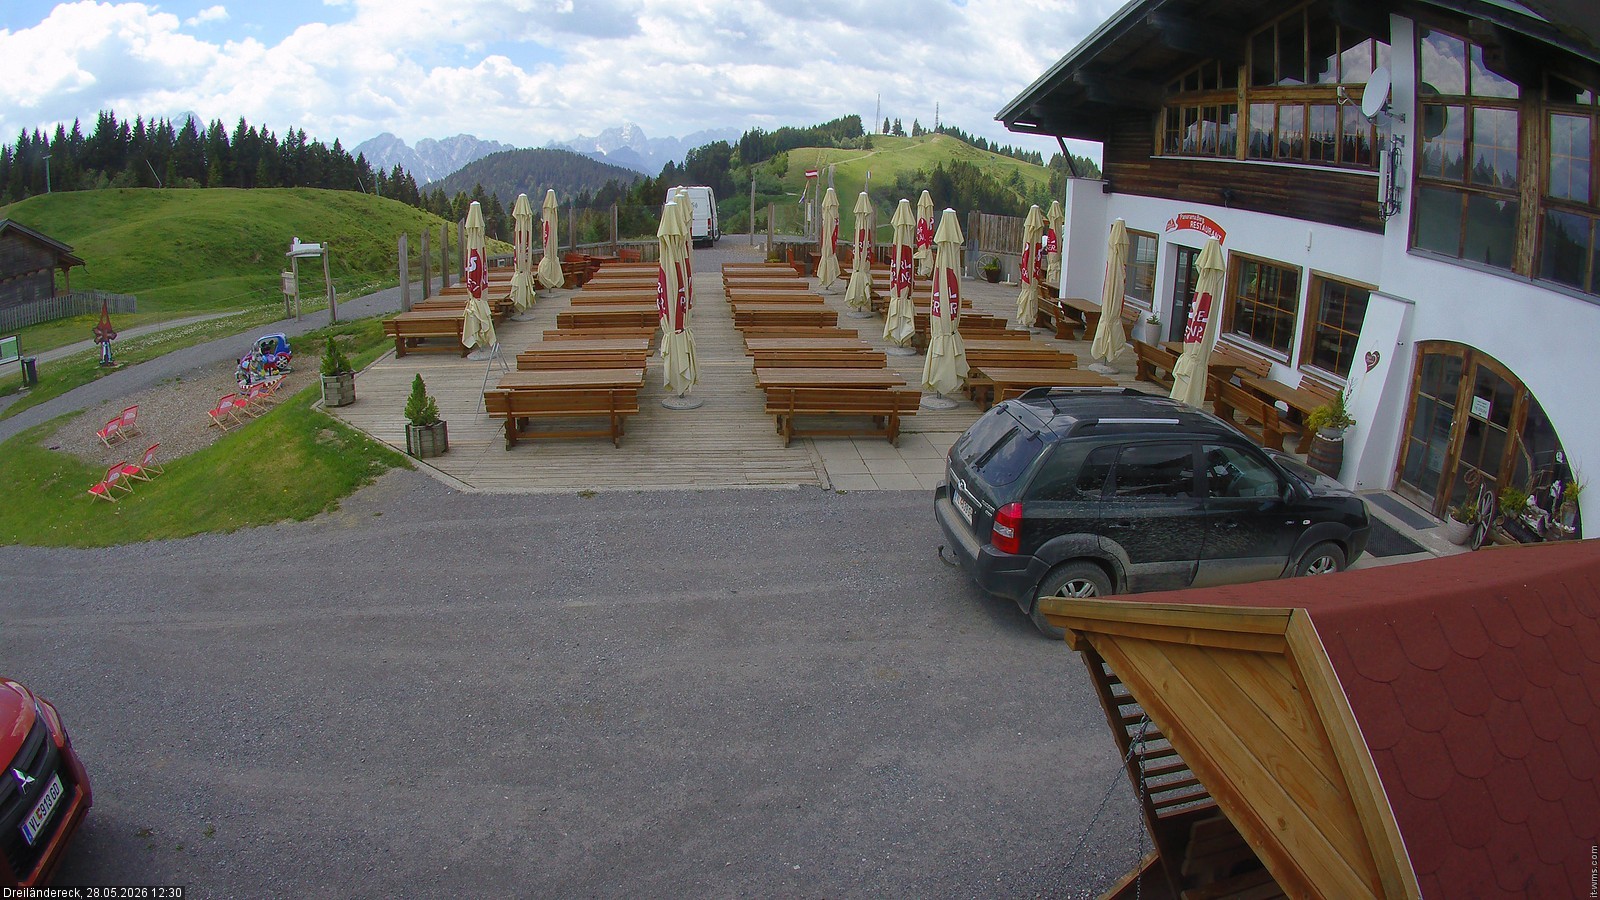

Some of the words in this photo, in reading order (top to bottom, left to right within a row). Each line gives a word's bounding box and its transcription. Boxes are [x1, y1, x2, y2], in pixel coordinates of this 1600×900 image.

[1189, 220, 1222, 240] RESTAURANT
[28, 815, 41, 833] VL
[40, 794, 53, 817] 913
[49, 782, 61, 800] GD
